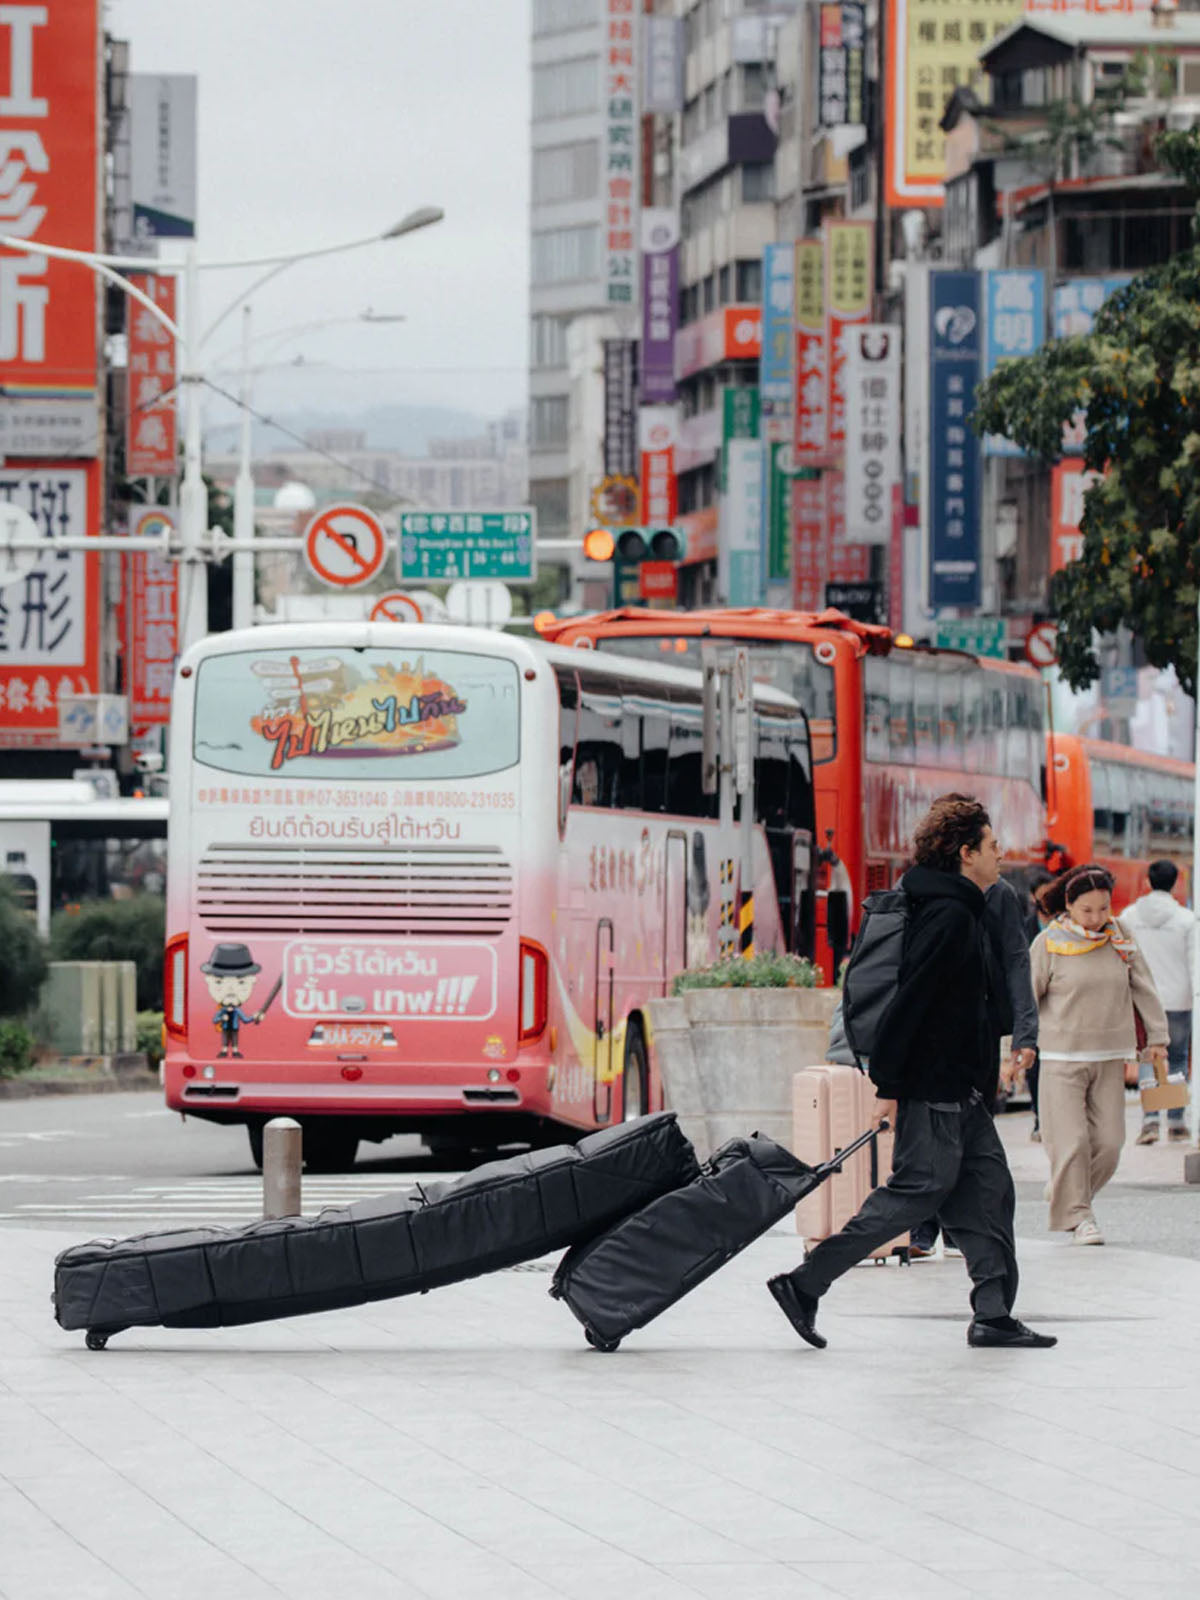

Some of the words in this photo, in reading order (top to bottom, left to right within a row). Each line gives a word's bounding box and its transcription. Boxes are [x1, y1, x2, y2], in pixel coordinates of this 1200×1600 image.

[249, 812, 461, 847] ยินดีต้อนรับสู่ไต้หวัน
[294, 945, 437, 976] ทัวร์ไต้หวัน
[373, 975, 479, 1014] เทพ!!!
